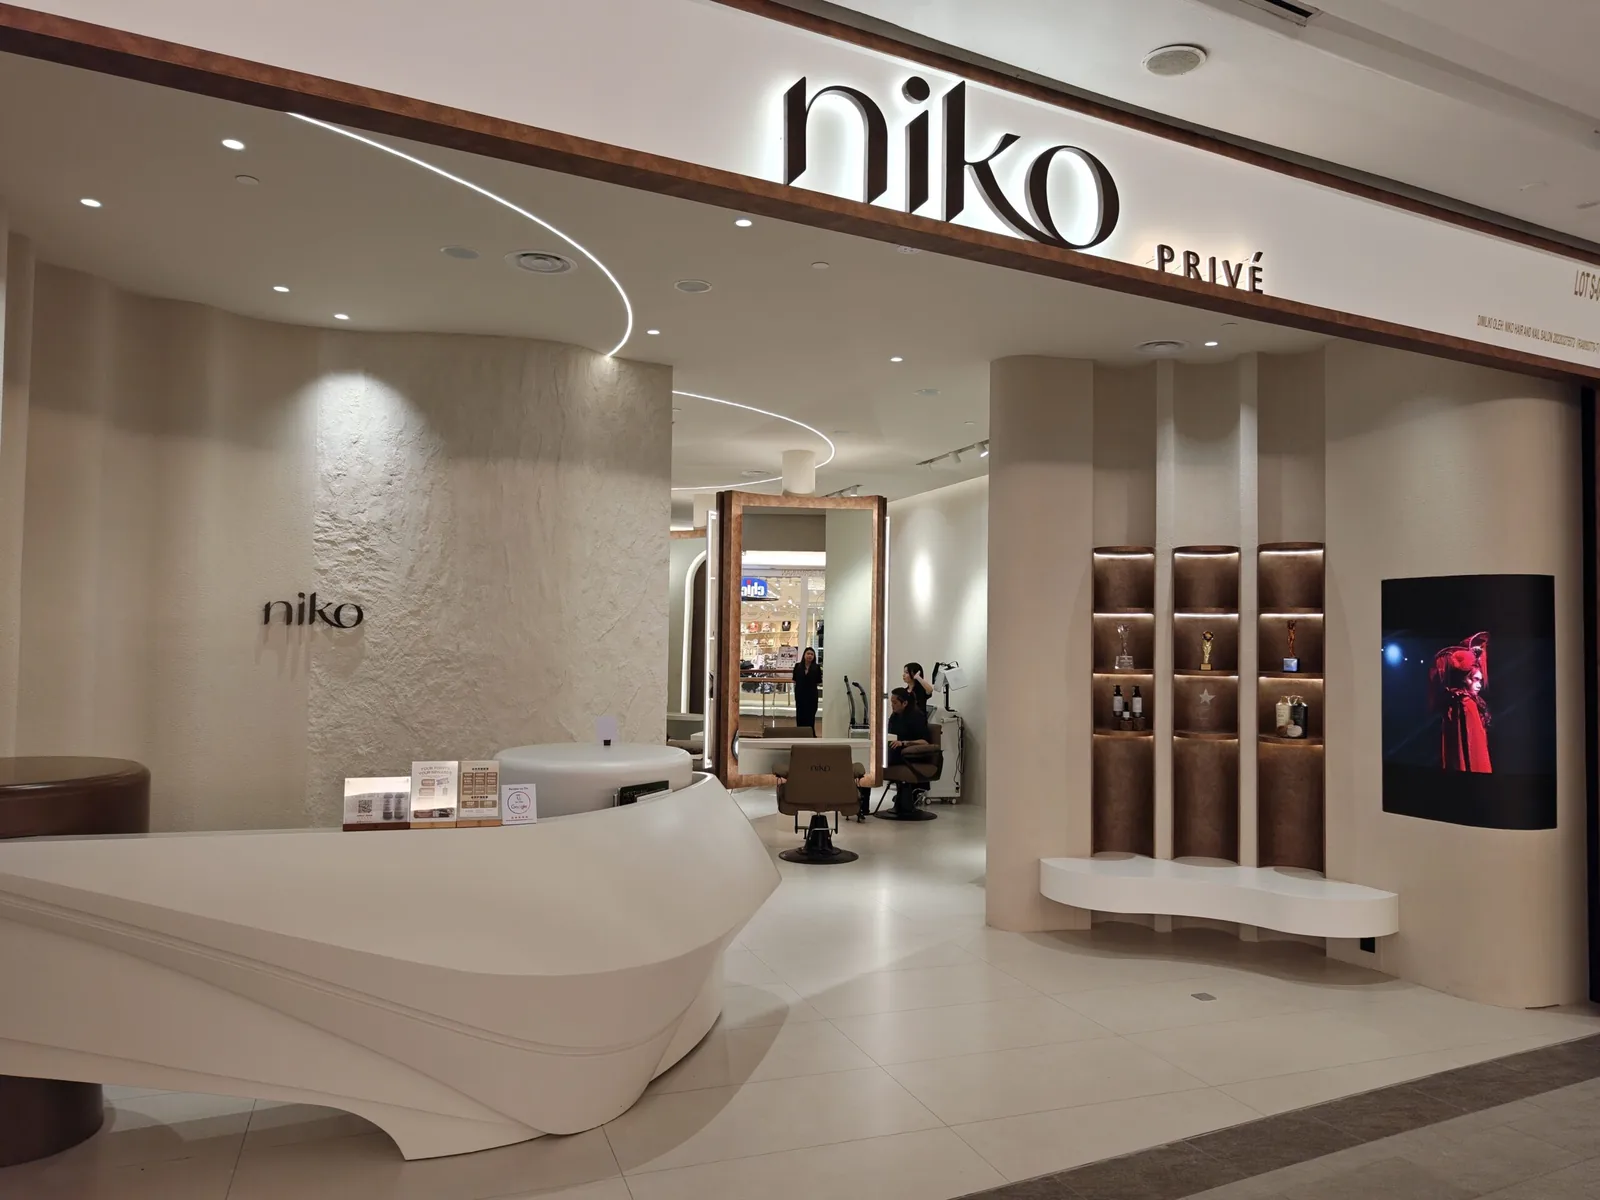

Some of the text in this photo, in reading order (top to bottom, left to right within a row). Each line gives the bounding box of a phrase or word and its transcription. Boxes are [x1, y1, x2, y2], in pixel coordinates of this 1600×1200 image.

[783, 76, 1120, 249] niko
[1157, 244, 1263, 294] PRIVÉ
[1574, 269, 1590, 298] LOT
[264, 592, 364, 628] niko
